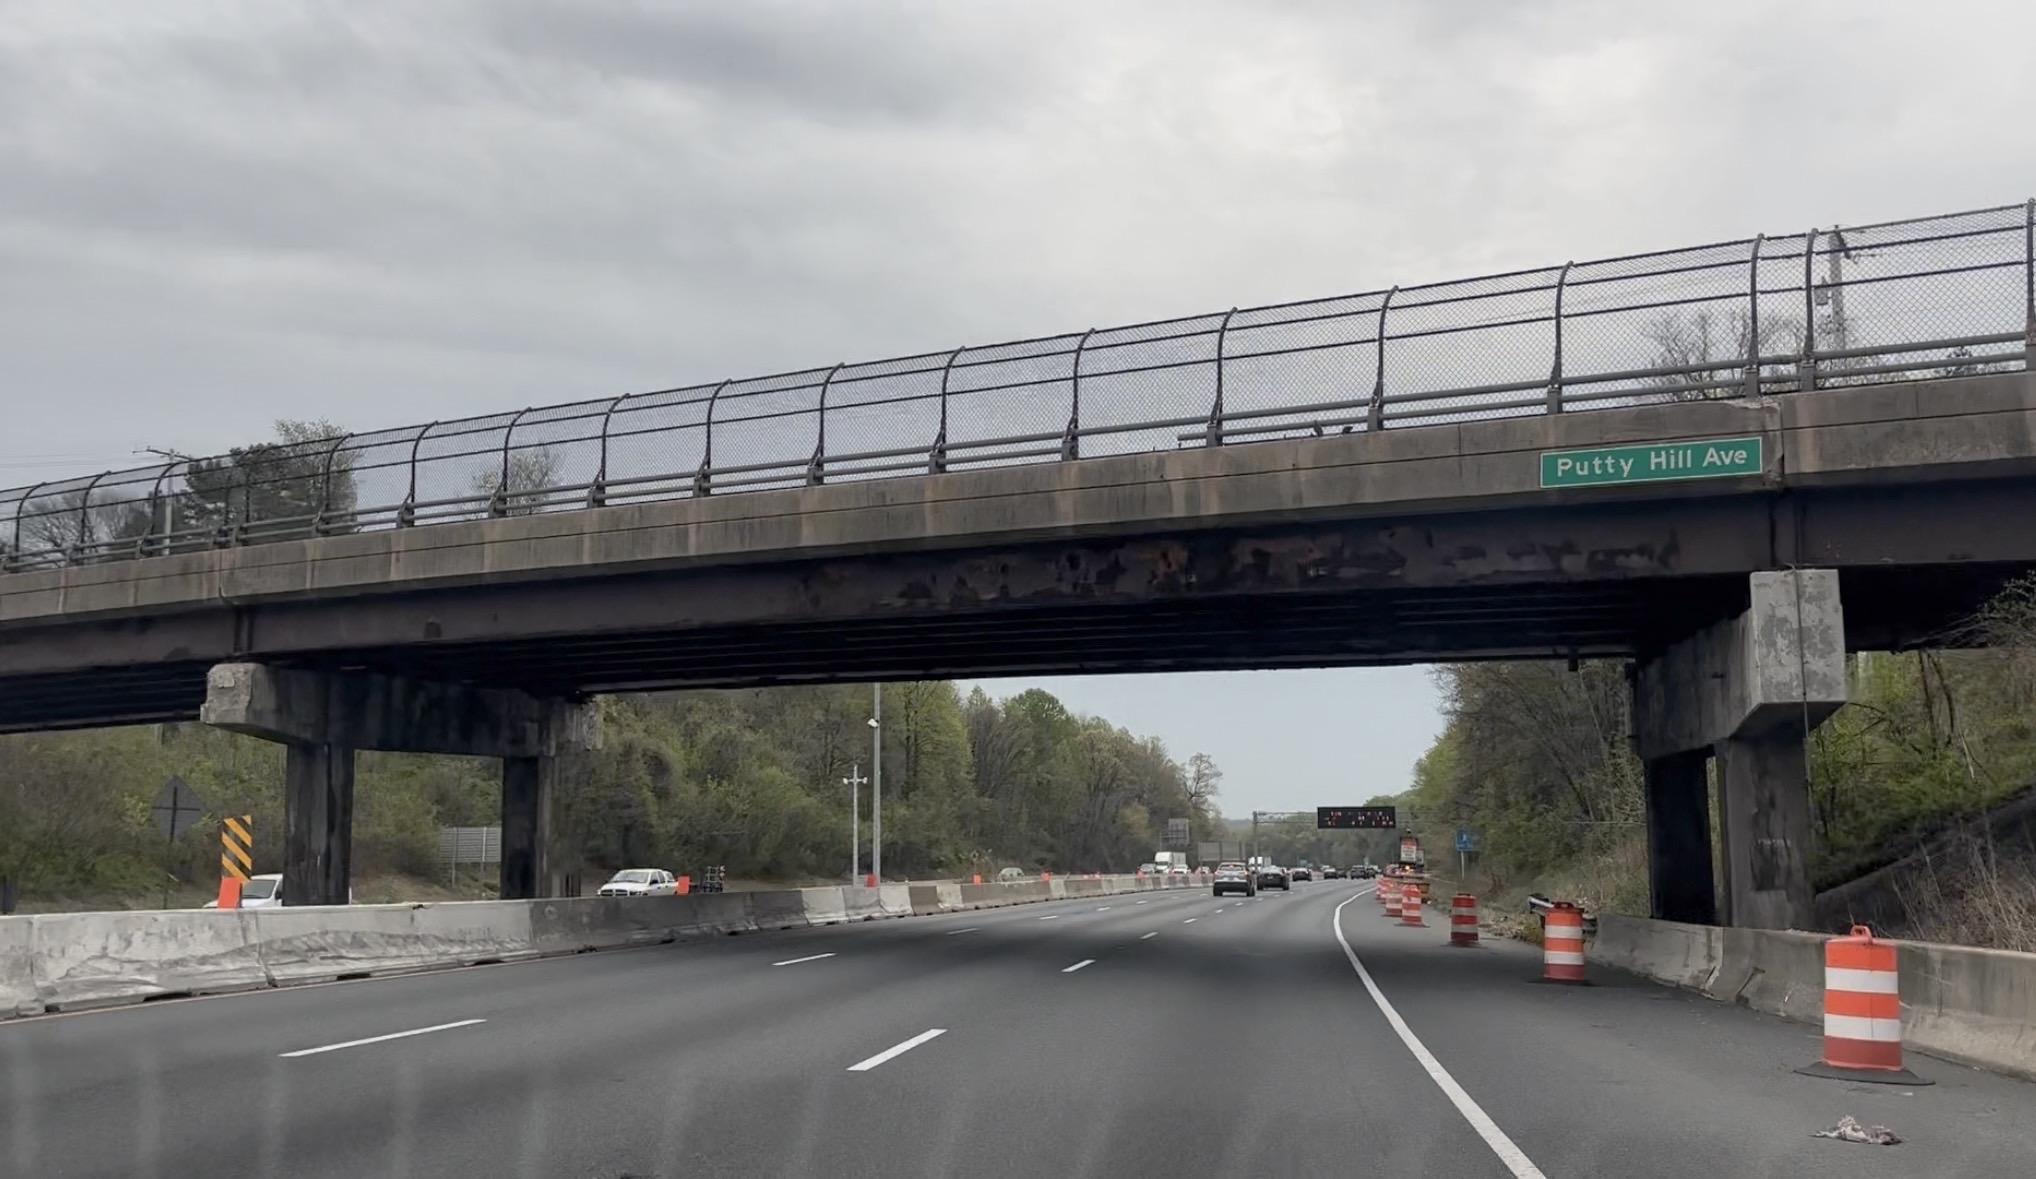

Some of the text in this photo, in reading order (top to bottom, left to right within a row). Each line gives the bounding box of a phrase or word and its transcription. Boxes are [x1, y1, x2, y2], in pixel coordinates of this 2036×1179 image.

[1557, 446, 1748, 477] Putty Hill Ave
